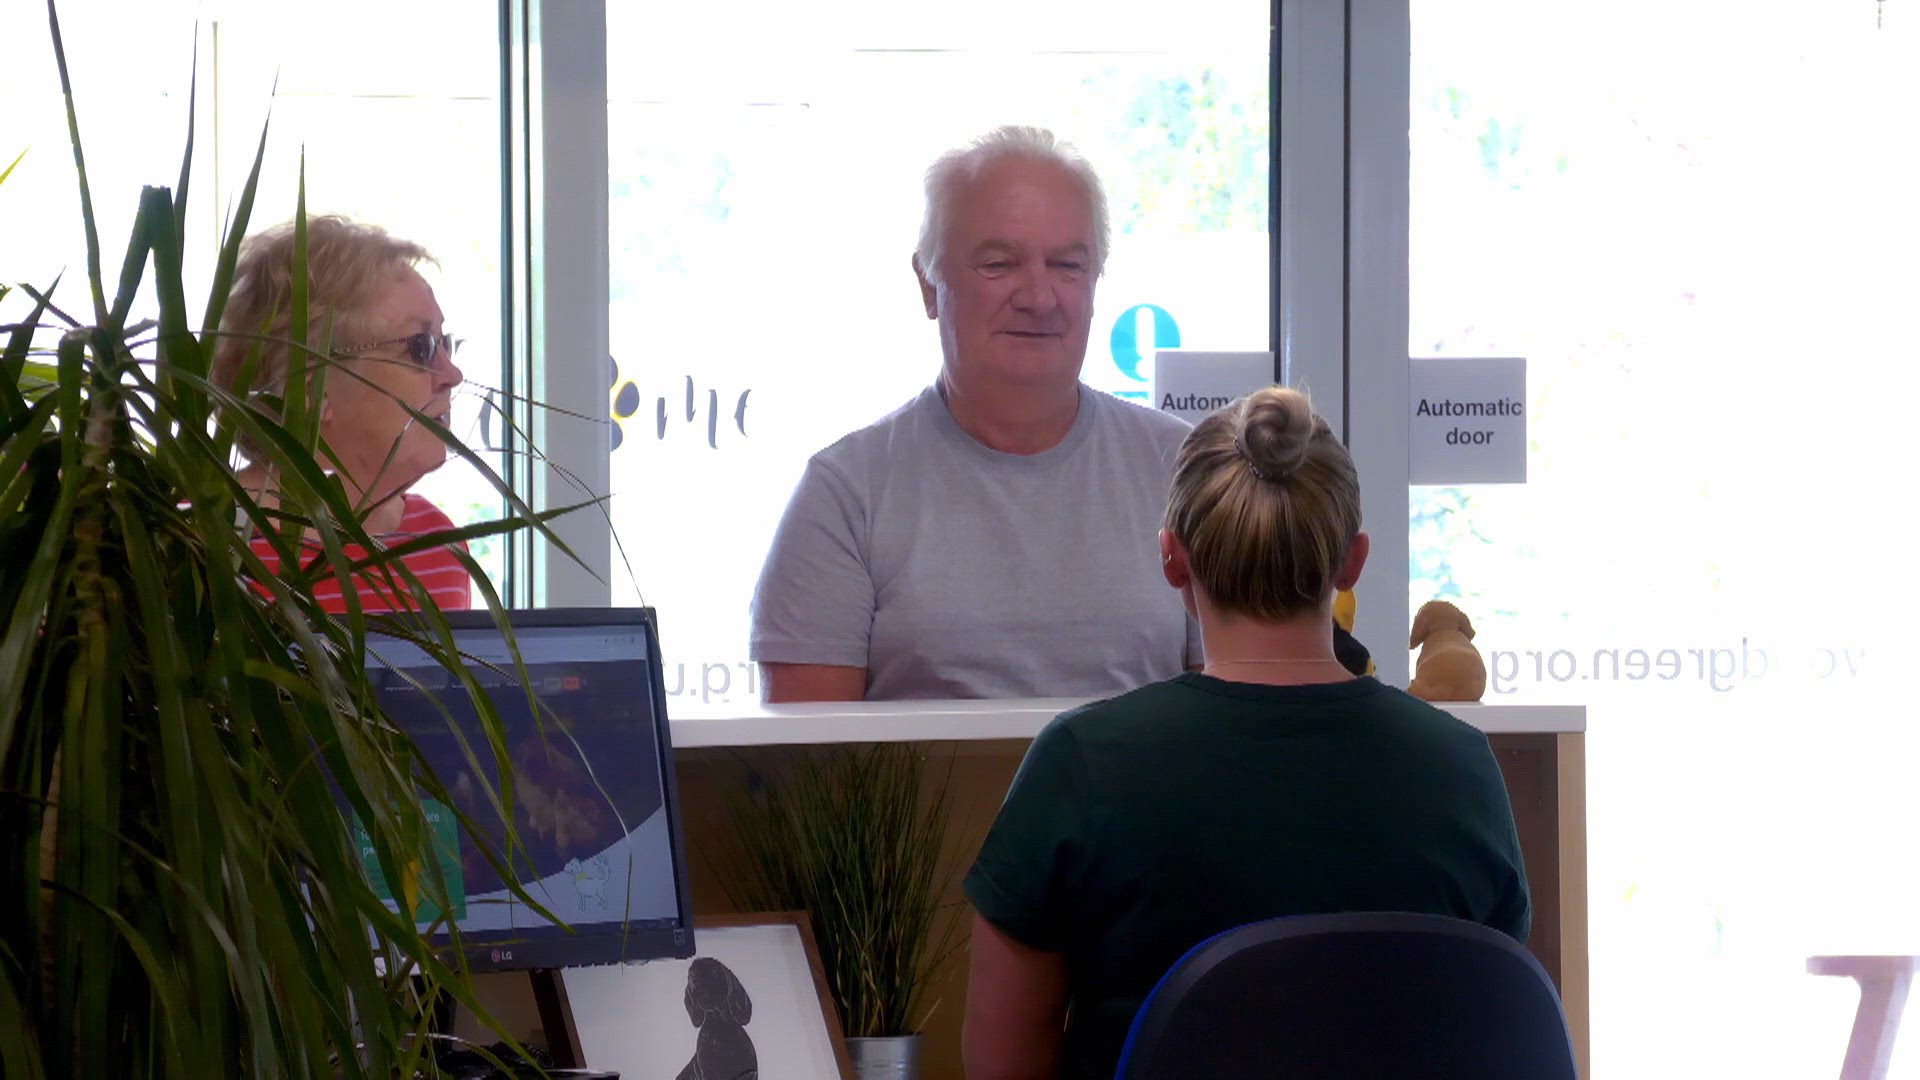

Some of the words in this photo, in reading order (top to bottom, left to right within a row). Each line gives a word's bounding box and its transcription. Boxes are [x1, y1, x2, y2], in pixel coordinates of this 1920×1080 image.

[1161, 393, 1233, 411] Autom
[1416, 397, 1523, 416] Automatic
[1445, 426, 1495, 445] door
[501, 950, 513, 961] LG
